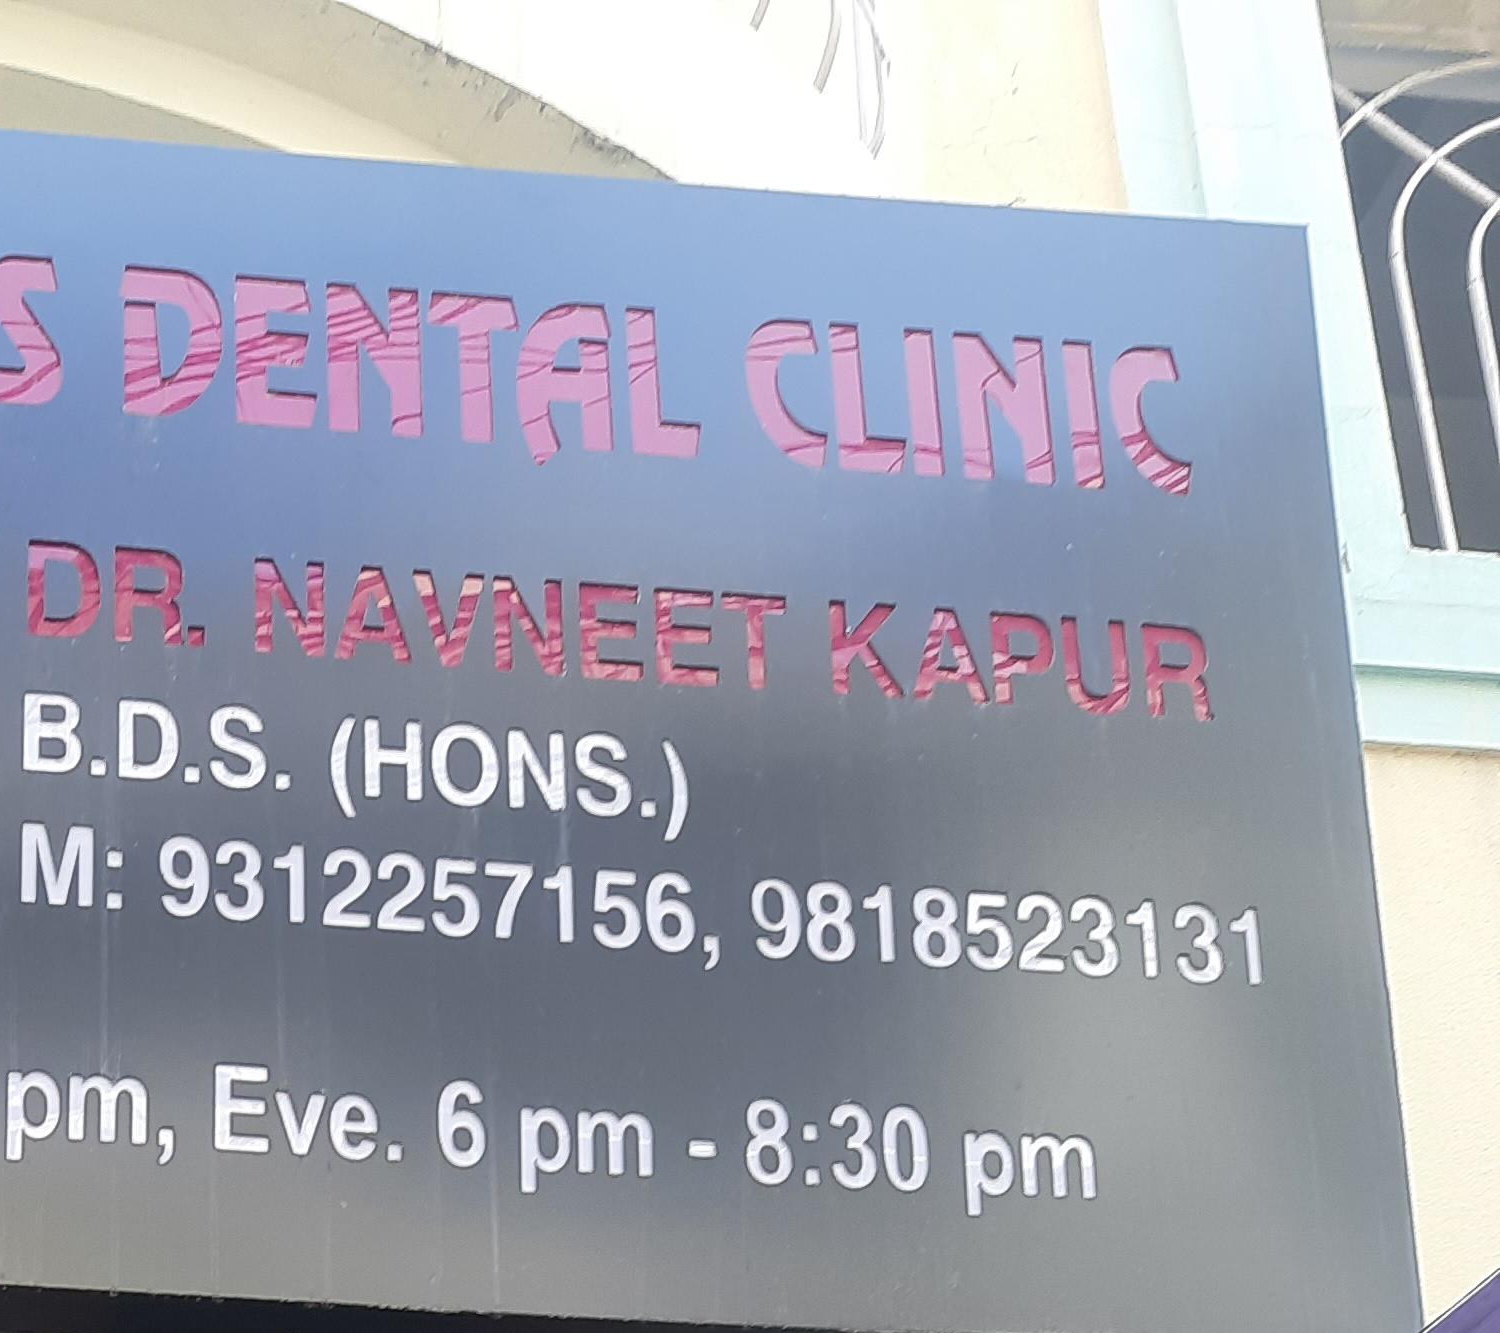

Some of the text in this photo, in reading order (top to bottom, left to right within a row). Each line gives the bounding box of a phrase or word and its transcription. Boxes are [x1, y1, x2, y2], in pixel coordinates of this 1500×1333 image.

[119, 263, 702, 467] DENTAL
[744, 318, 1192, 495] CLINIC
[26, 539, 1215, 724] DR. NAVNEET KAPUR
[21, 691, 690, 843] B.D.S. (HONS.)
[19, 821, 1262, 988] M: 9312257156, 9818523131
[4, 1065, 177, 1168] pm,
[212, 1062, 405, 1163] Eve.
[435, 1079, 489, 1170] 6
[518, 1102, 657, 1195] pm
[743, 1098, 932, 1194] 8:30
[963, 1125, 1100, 1217] pm
